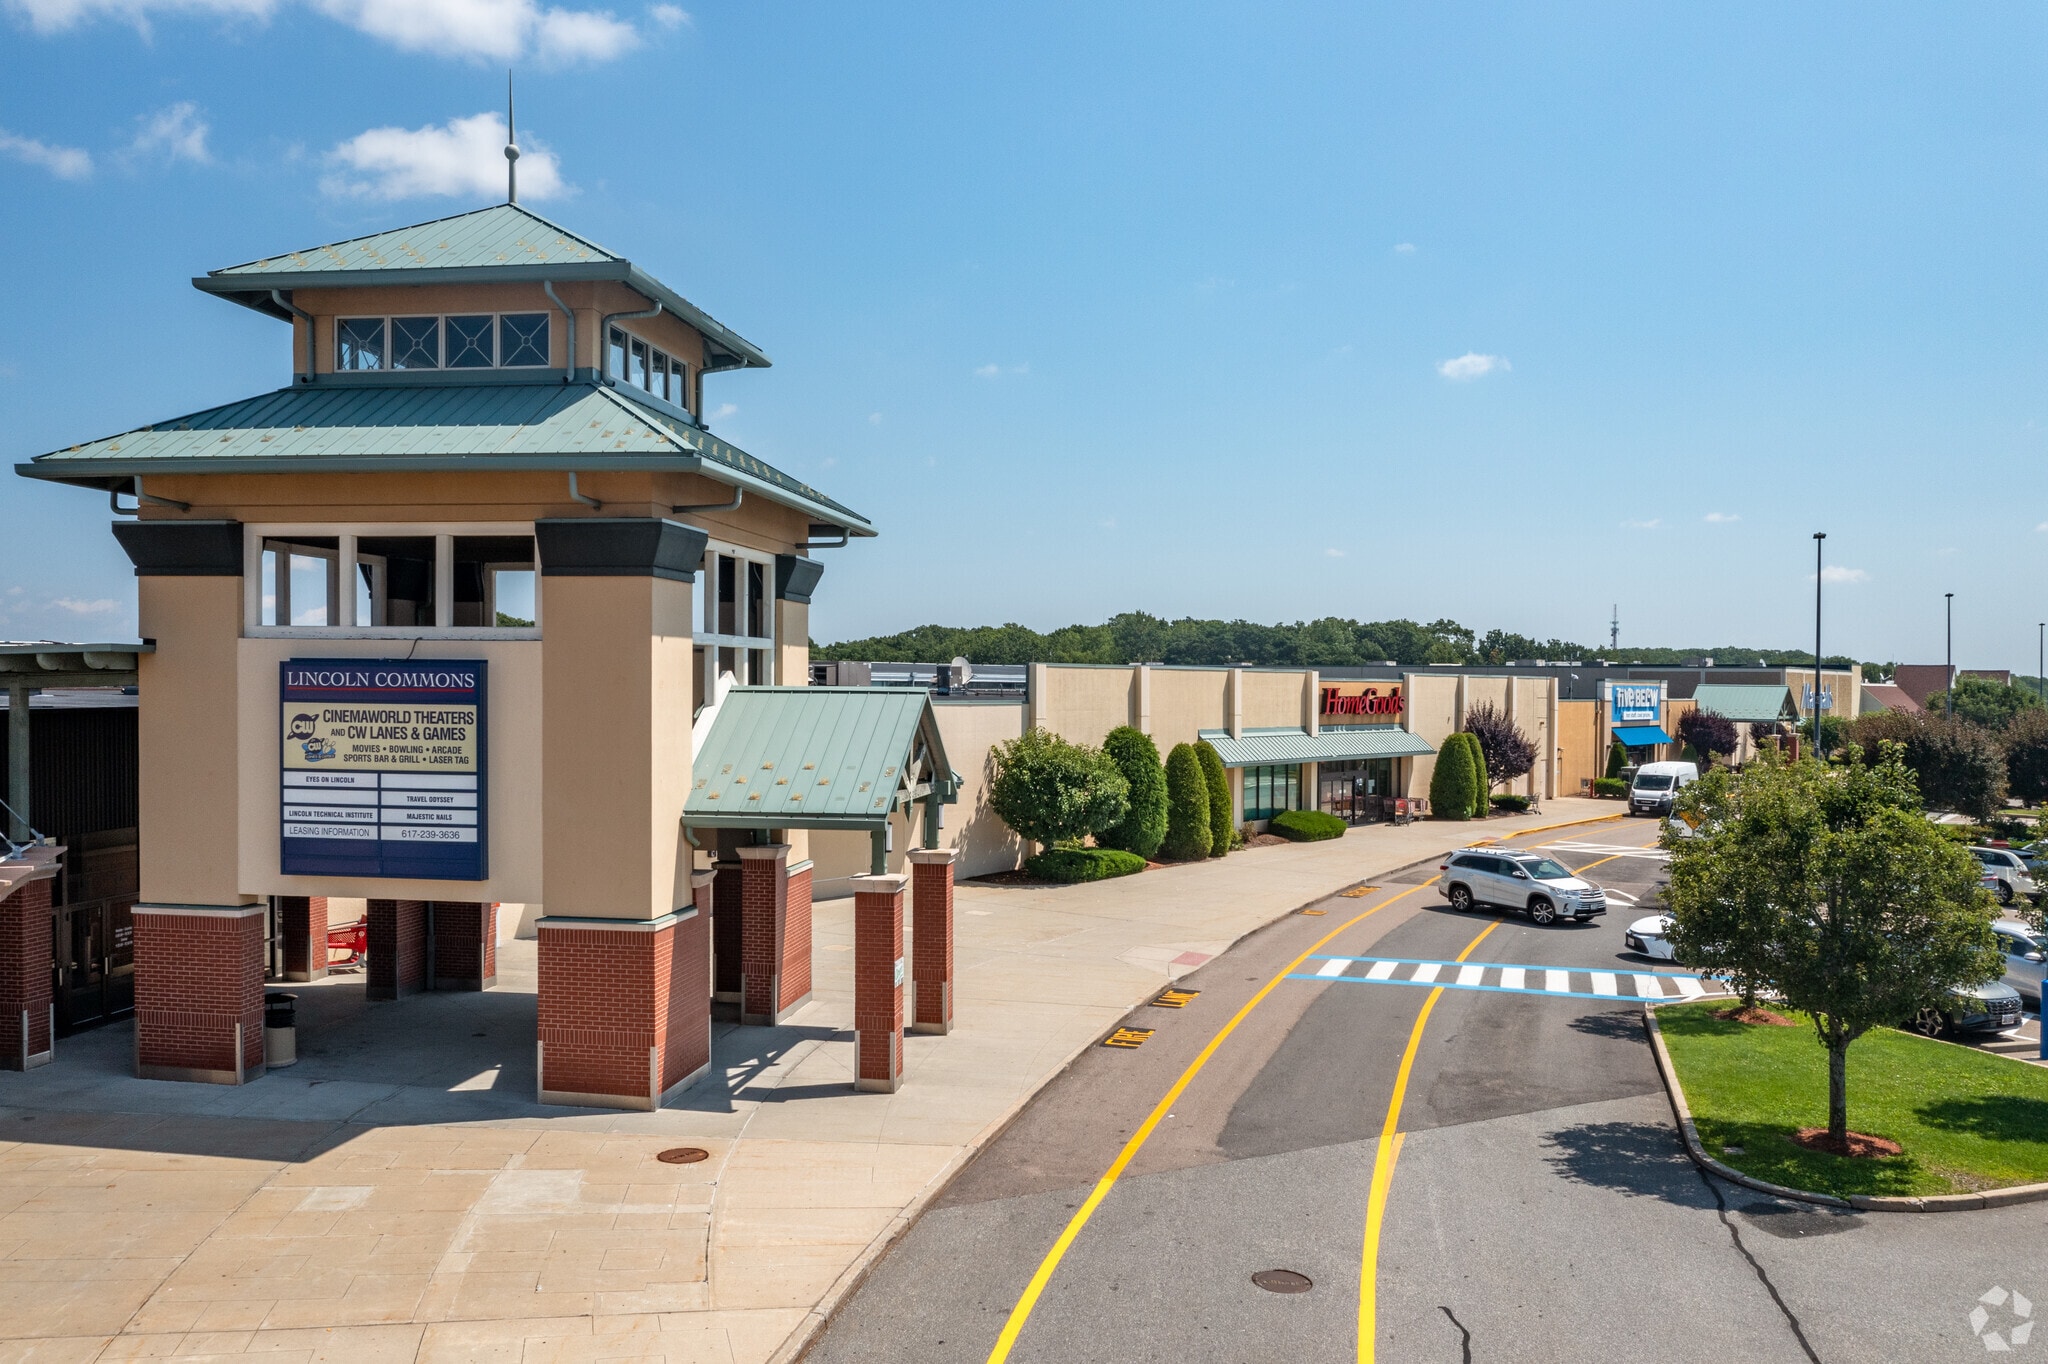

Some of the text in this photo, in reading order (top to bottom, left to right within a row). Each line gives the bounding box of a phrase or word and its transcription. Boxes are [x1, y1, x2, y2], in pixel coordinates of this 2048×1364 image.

[287, 671, 475, 688] LINCOLN COMMONS
[1321, 686, 1406, 715] HomeGoods
[1801, 683, 1833, 709] Maalls
[323, 709, 474, 725] CINEMAWORLD THEATERS
[291, 720, 314, 733] CW
[331, 725, 466, 741] AND CW LANES & GAMES
[352, 744, 462, 755] MOVIES BOWLING ARCADE
[343, 754, 372, 762] SPORTS
[390, 755, 398, 763] &
[398, 755, 420, 763] GRILL
[429, 756, 453, 764] LASER
[455, 756, 469, 765] TAG
[406, 795, 455, 804] TRAVEL ODYSSEY
[406, 813, 435, 821] MAJESTIC
[289, 826, 370, 837] LEASING INFORMATION
[401, 829, 460, 839] 617-239-3636
